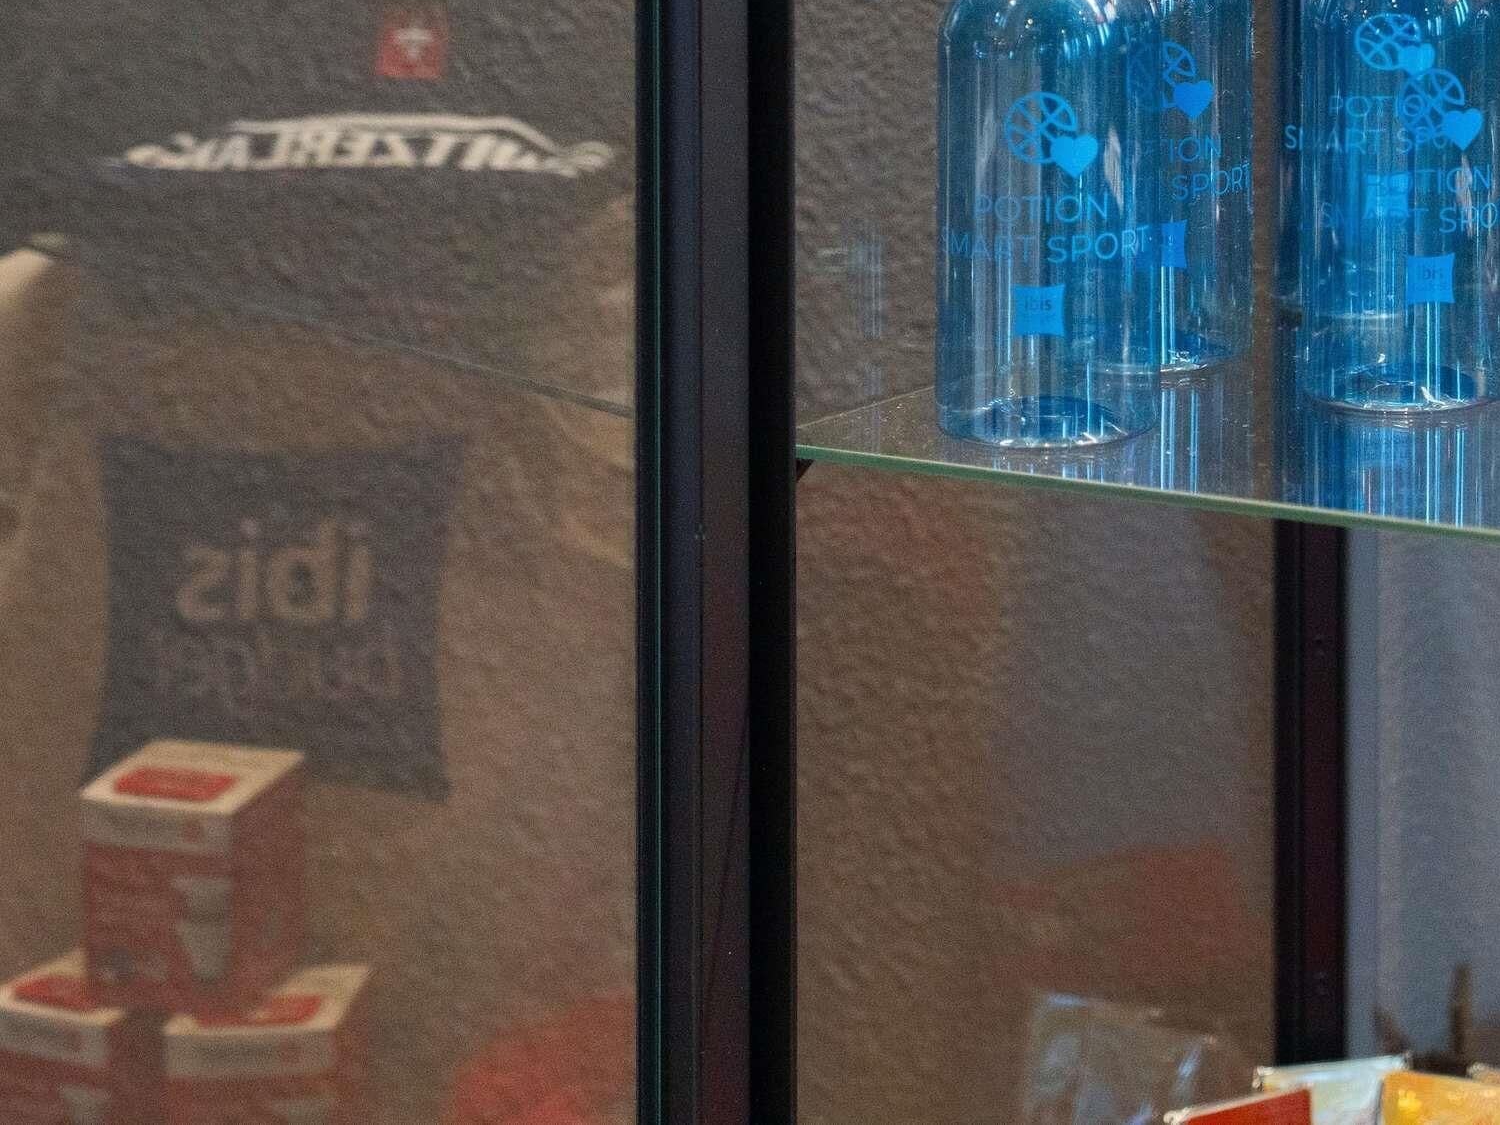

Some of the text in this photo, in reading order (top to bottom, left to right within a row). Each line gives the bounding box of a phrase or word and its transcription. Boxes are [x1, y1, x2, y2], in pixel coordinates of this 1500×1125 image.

[1168, 136, 1221, 163] ION
[973, 190, 1108, 225] POTION
[1046, 226, 1149, 264] SPORT
